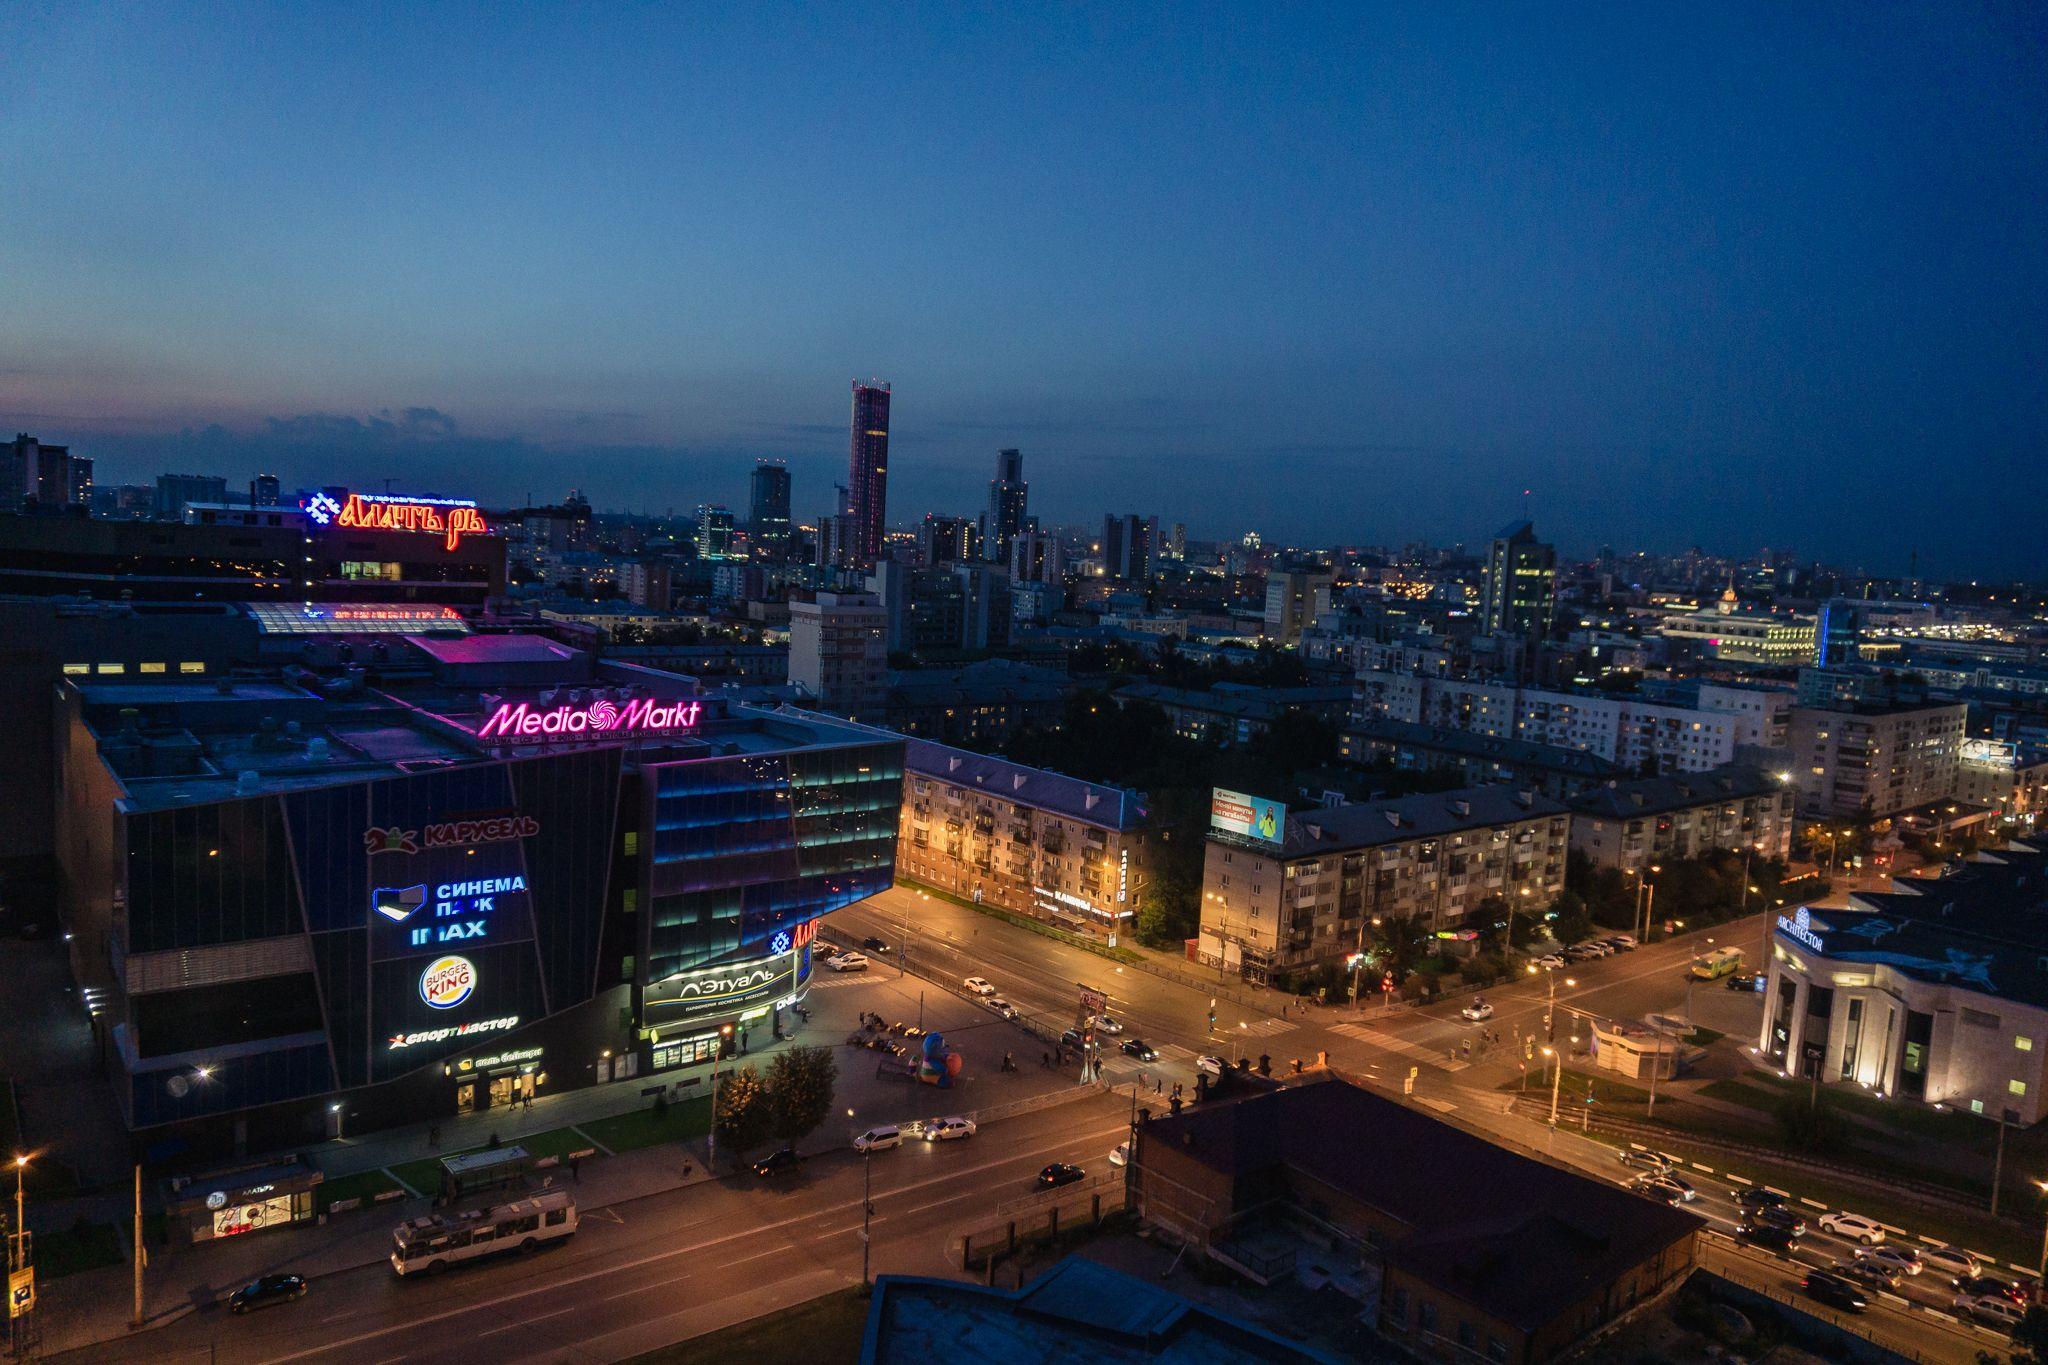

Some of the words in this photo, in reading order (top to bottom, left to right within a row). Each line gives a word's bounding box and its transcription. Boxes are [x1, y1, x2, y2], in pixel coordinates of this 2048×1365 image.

[478, 702, 588, 737] Media
[611, 698, 701, 730] Markt
[424, 816, 540, 847] КАРУСЕЛЬ
[437, 876, 525, 899] СИНЕМА
[426, 963, 468, 988] BURGER
[427, 971, 470, 1000] KING
